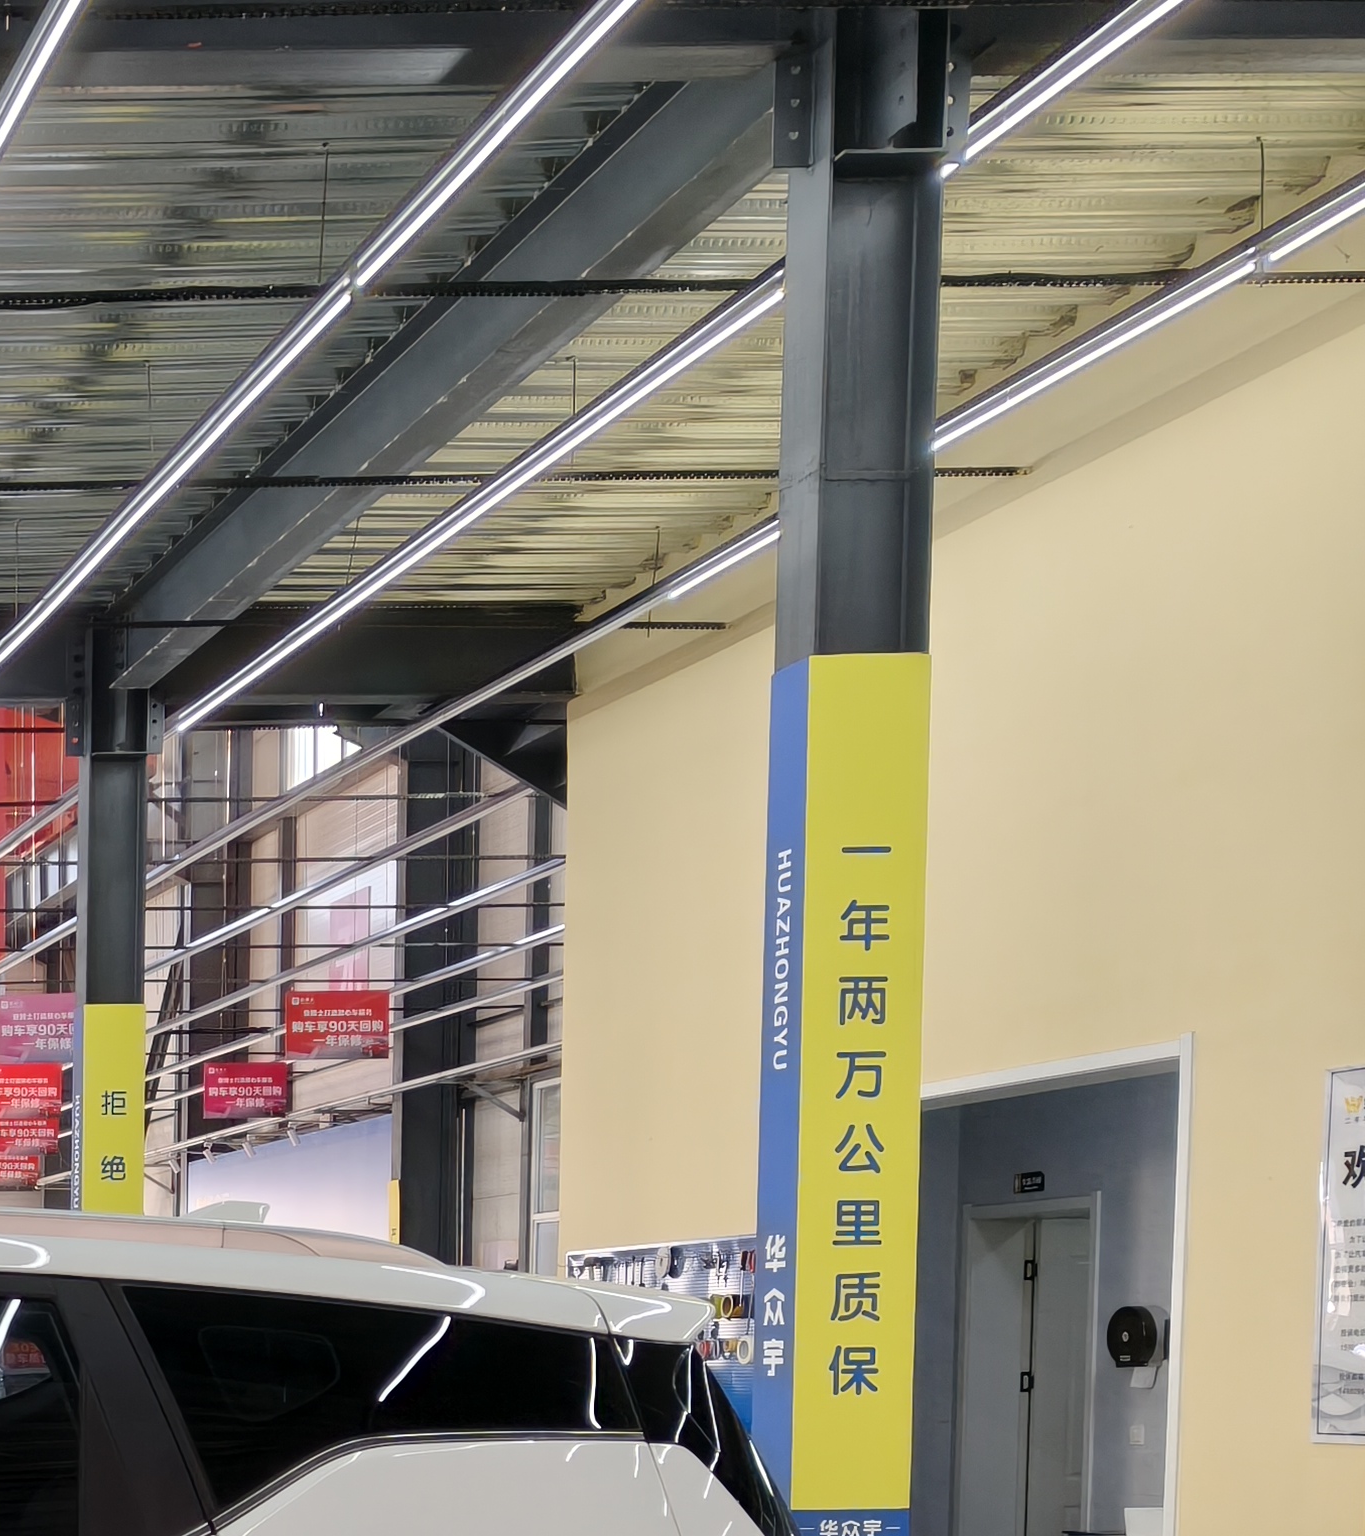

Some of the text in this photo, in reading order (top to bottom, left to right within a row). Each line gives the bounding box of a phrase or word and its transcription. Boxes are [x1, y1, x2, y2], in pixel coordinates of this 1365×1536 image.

[772, 848, 793, 1072] HUAZHONGYU
[22, 1038, 72, 1050] 一年保修
[292, 1019, 384, 1033] 购车享90天回购
[313, 1034, 363, 1047] 一年保修
[101, 1090, 127, 1180] 拒绝
[208, 1086, 282, 1096] 购车享90天回购
[828, 846, 892, 1396] 一年两万公里质保
[73, 1094, 81, 1208] HUAZHONGYU
[762, 1234, 786, 1377] 华众宇
